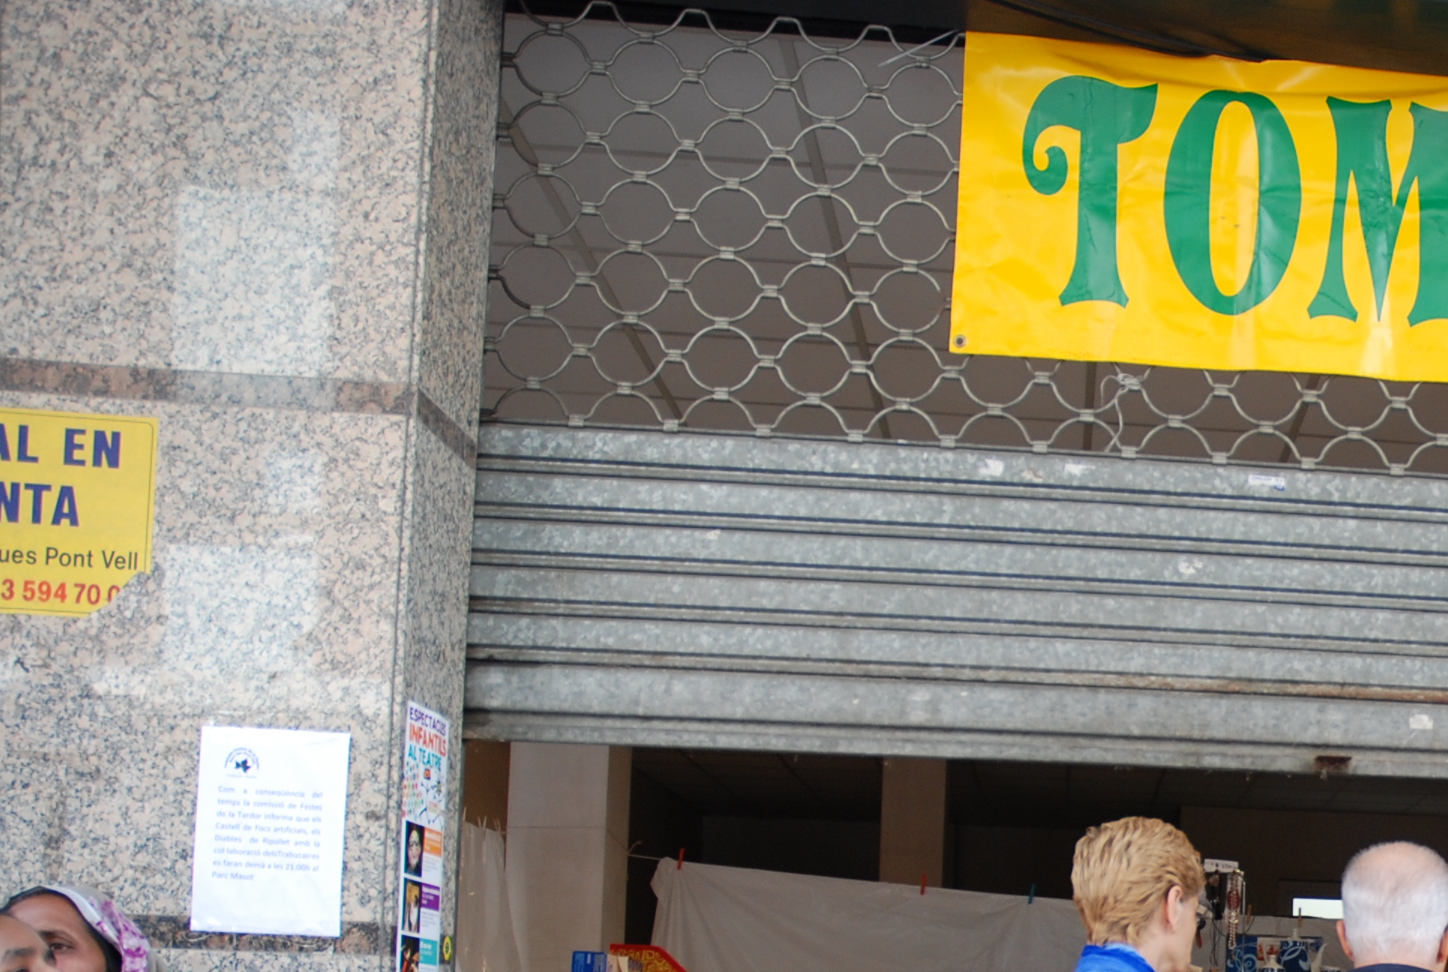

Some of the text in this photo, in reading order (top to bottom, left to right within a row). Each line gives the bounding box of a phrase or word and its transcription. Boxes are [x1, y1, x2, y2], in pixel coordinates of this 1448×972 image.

[63, 428, 121, 469] EN
[0, 481, 79, 527] NTA
[45, 547, 94, 568] Pont
[102, 550, 138, 571] Vell
[1, 579, 15, 601] 3
[22, 580, 68, 604] 594
[73, 583, 101, 606] 70
[409, 722, 447, 757] INFANTILS
[408, 744, 442, 772] AL TEATRE
[218, 785, 235, 793] Com
[312, 791, 323, 799] del
[217, 798, 240, 807] temps
[238, 811, 262, 819] Tardor
[264, 812, 293, 822] informa
[296, 816, 310, 824] que
[312, 815, 322, 823] els
[215, 822, 240, 830] Castell
[249, 836, 259, 844] de
[262, 837, 290, 846] Ripollet
[314, 840, 320, 848] la
[223, 859, 242, 867] faran
[273, 862, 283, 870] les
[212, 871, 228, 879] Parc
